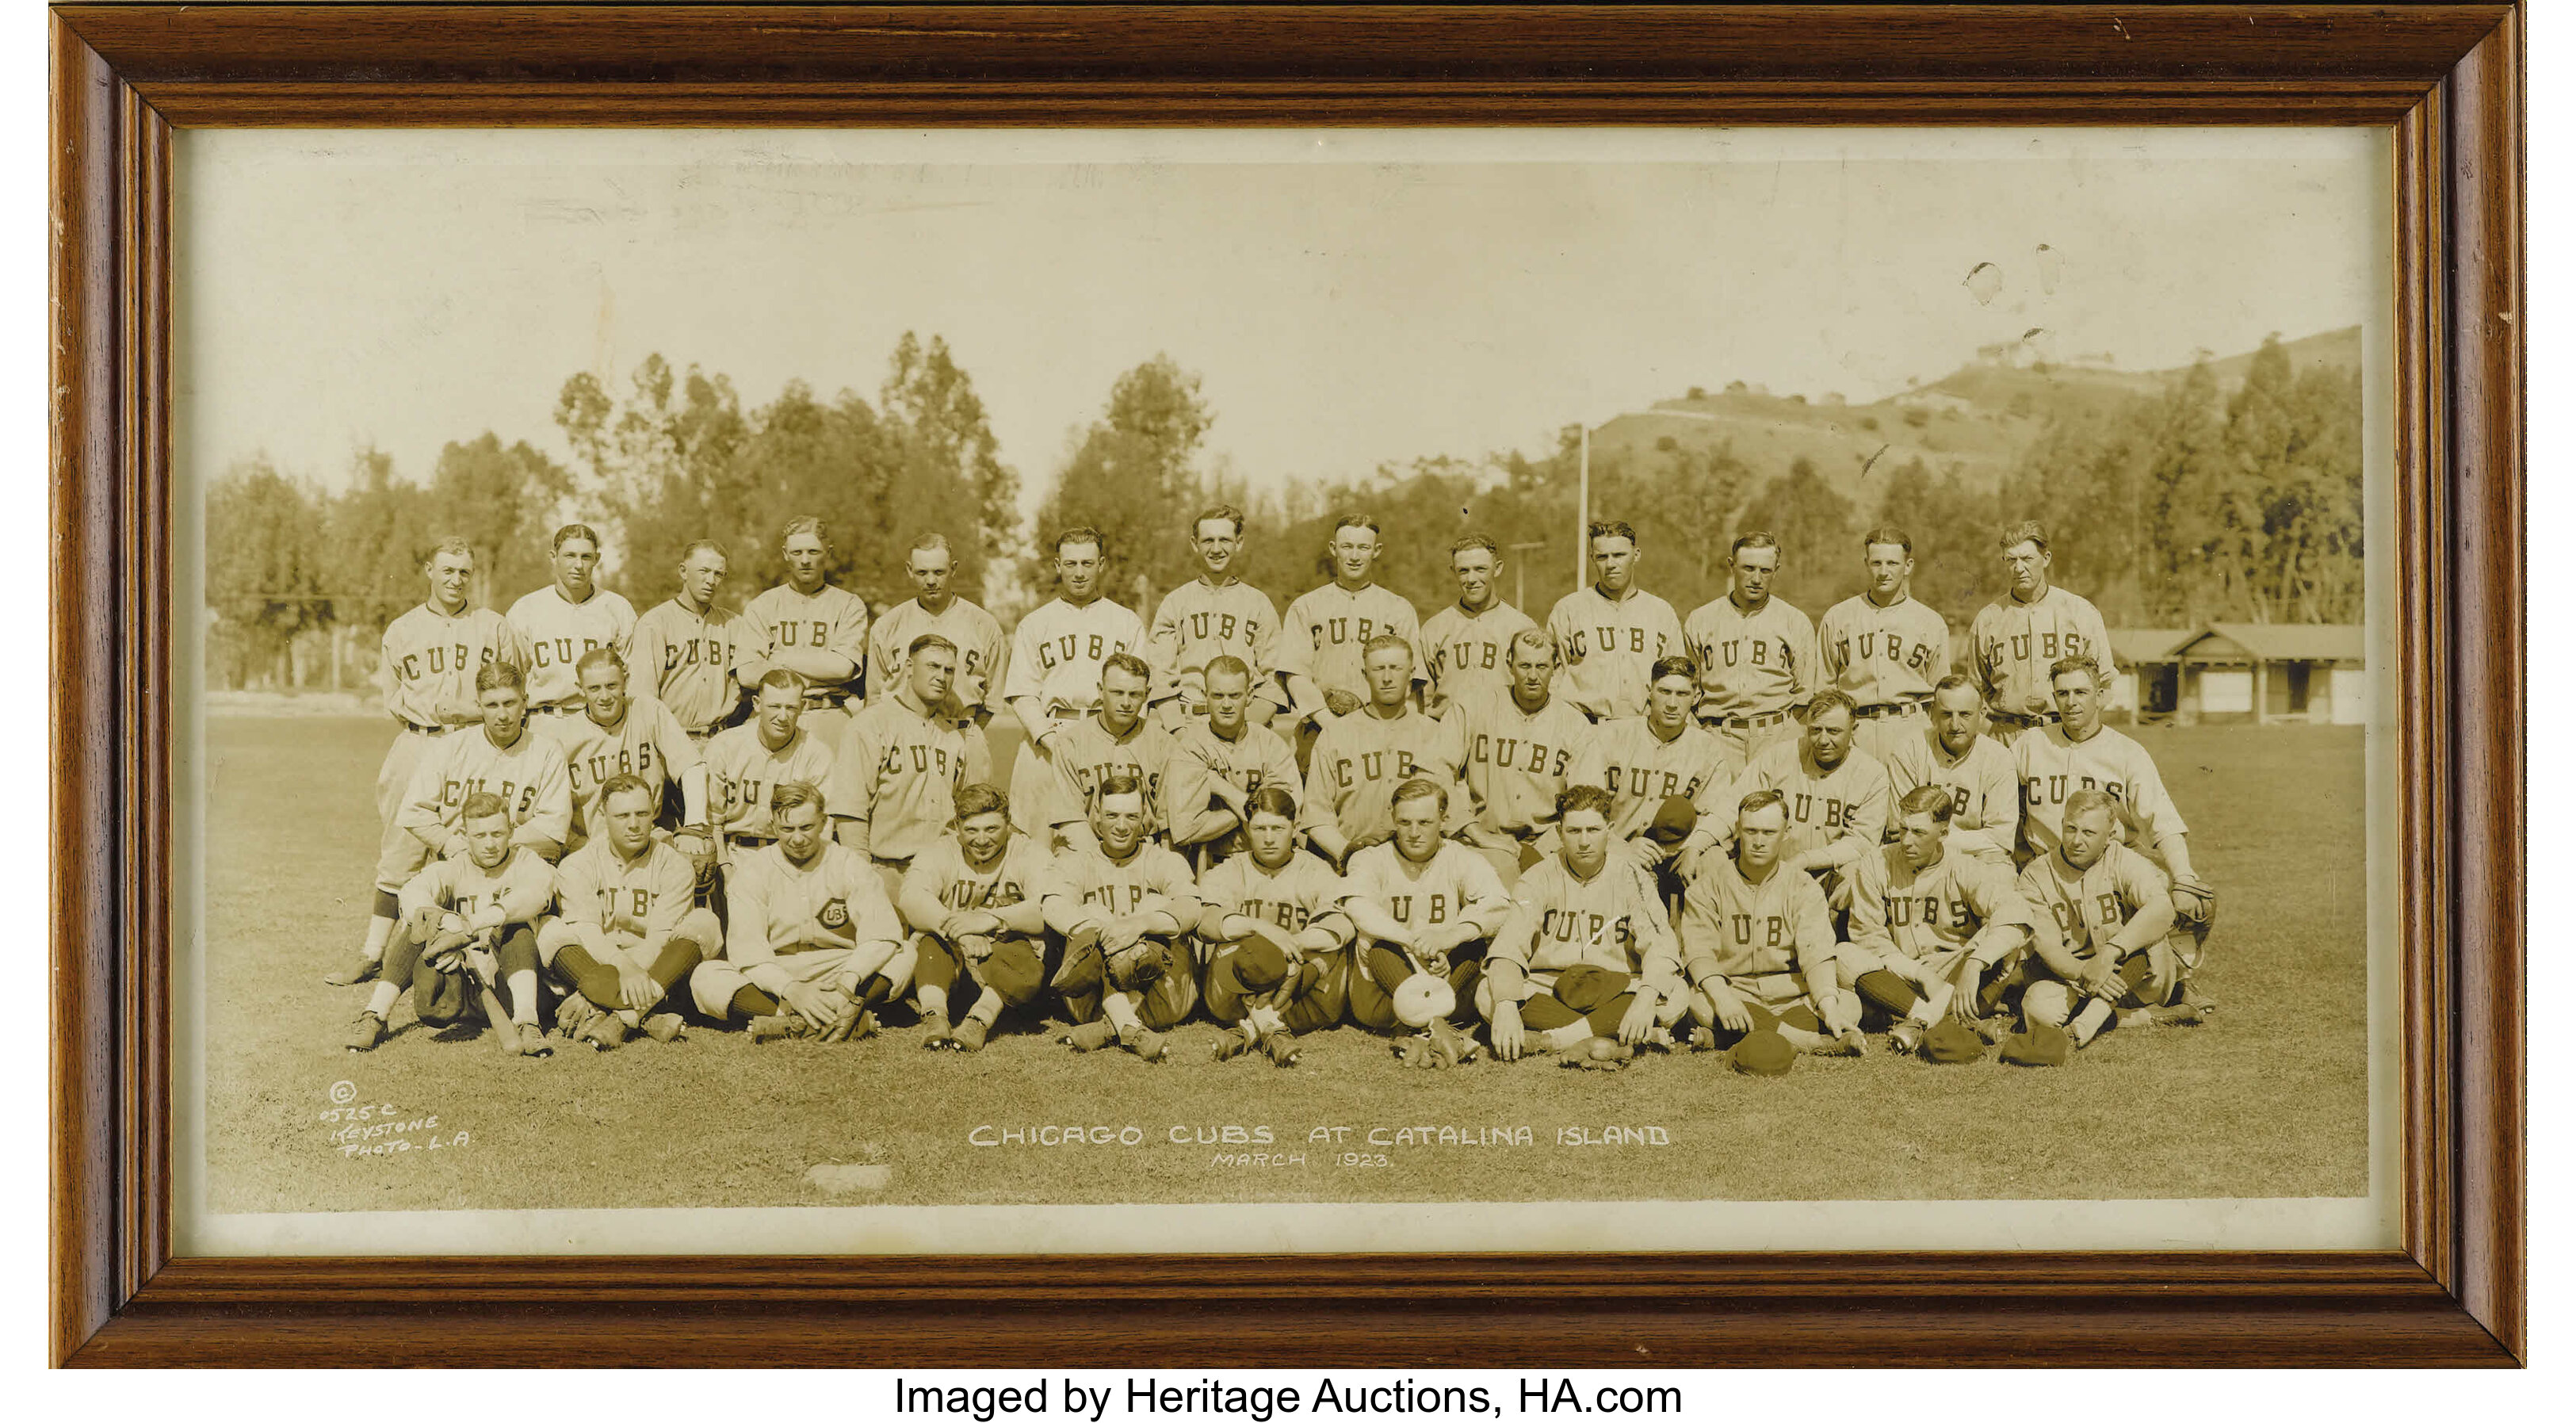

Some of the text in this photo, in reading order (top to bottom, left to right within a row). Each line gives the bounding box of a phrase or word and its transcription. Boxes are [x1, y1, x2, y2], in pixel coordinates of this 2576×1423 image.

[403, 643, 493, 680] CUBS
[1992, 633, 2080, 668] CUBS
[569, 742, 651, 790] CUBS
[1477, 733, 1572, 777] CUBS
[1604, 766, 1701, 800] CUBS
[1542, 909, 1631, 946] CUBS
[331, 1115, 439, 1144] KEYSTONE
[969, 1124, 1670, 1147] CHICAGO CUBS AT CATALINA ISLAND
[1210, 1153, 1307, 1169] MARCH
